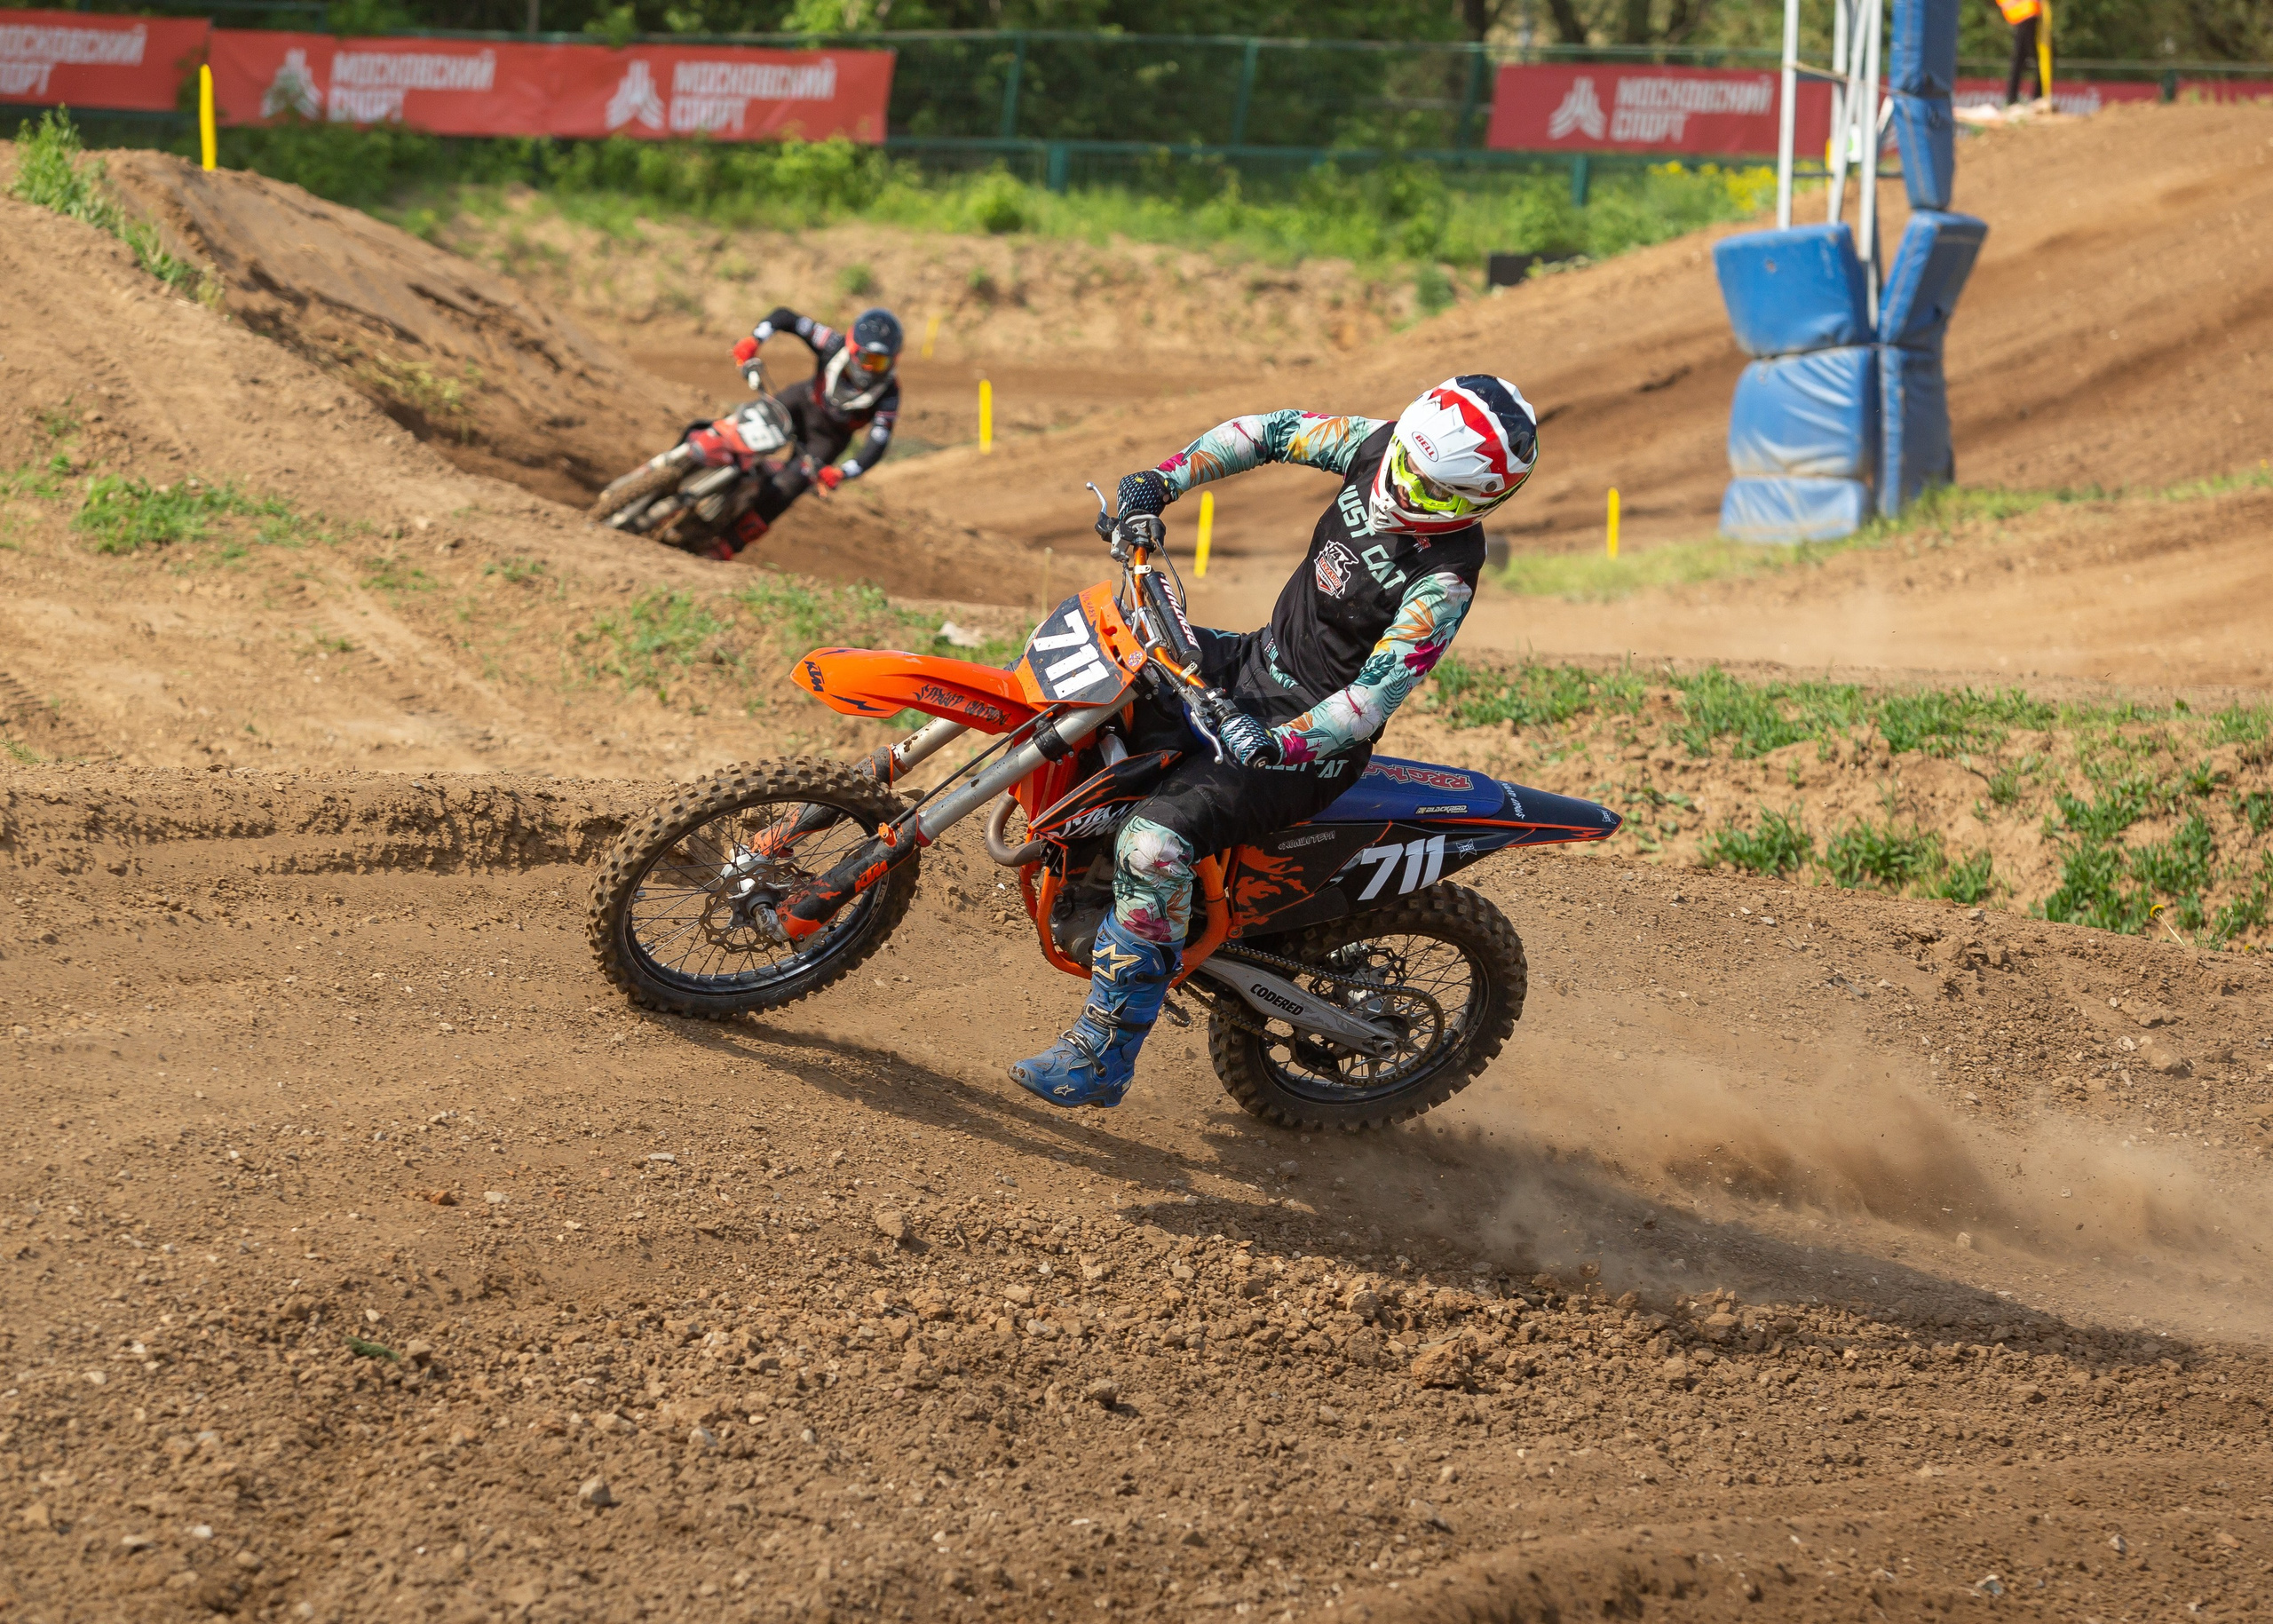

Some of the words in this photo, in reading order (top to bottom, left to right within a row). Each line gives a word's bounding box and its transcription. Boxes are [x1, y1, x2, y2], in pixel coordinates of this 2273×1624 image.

[1414, 434, 1436, 458] BELL
[1319, 557, 1342, 589] NAZAROV
[1361, 544, 1407, 590] CAT
[1160, 577, 1201, 651] RENTHAL
[1033, 608, 1110, 700] 711
[804, 661, 826, 693] KTM
[1406, 766, 1474, 791] RRG
[1426, 804, 1468, 813] BLACKBIRD
[854, 860, 888, 893] KTM
[1357, 835, 1446, 901] 711
[1250, 983, 1304, 1016] CODERED
